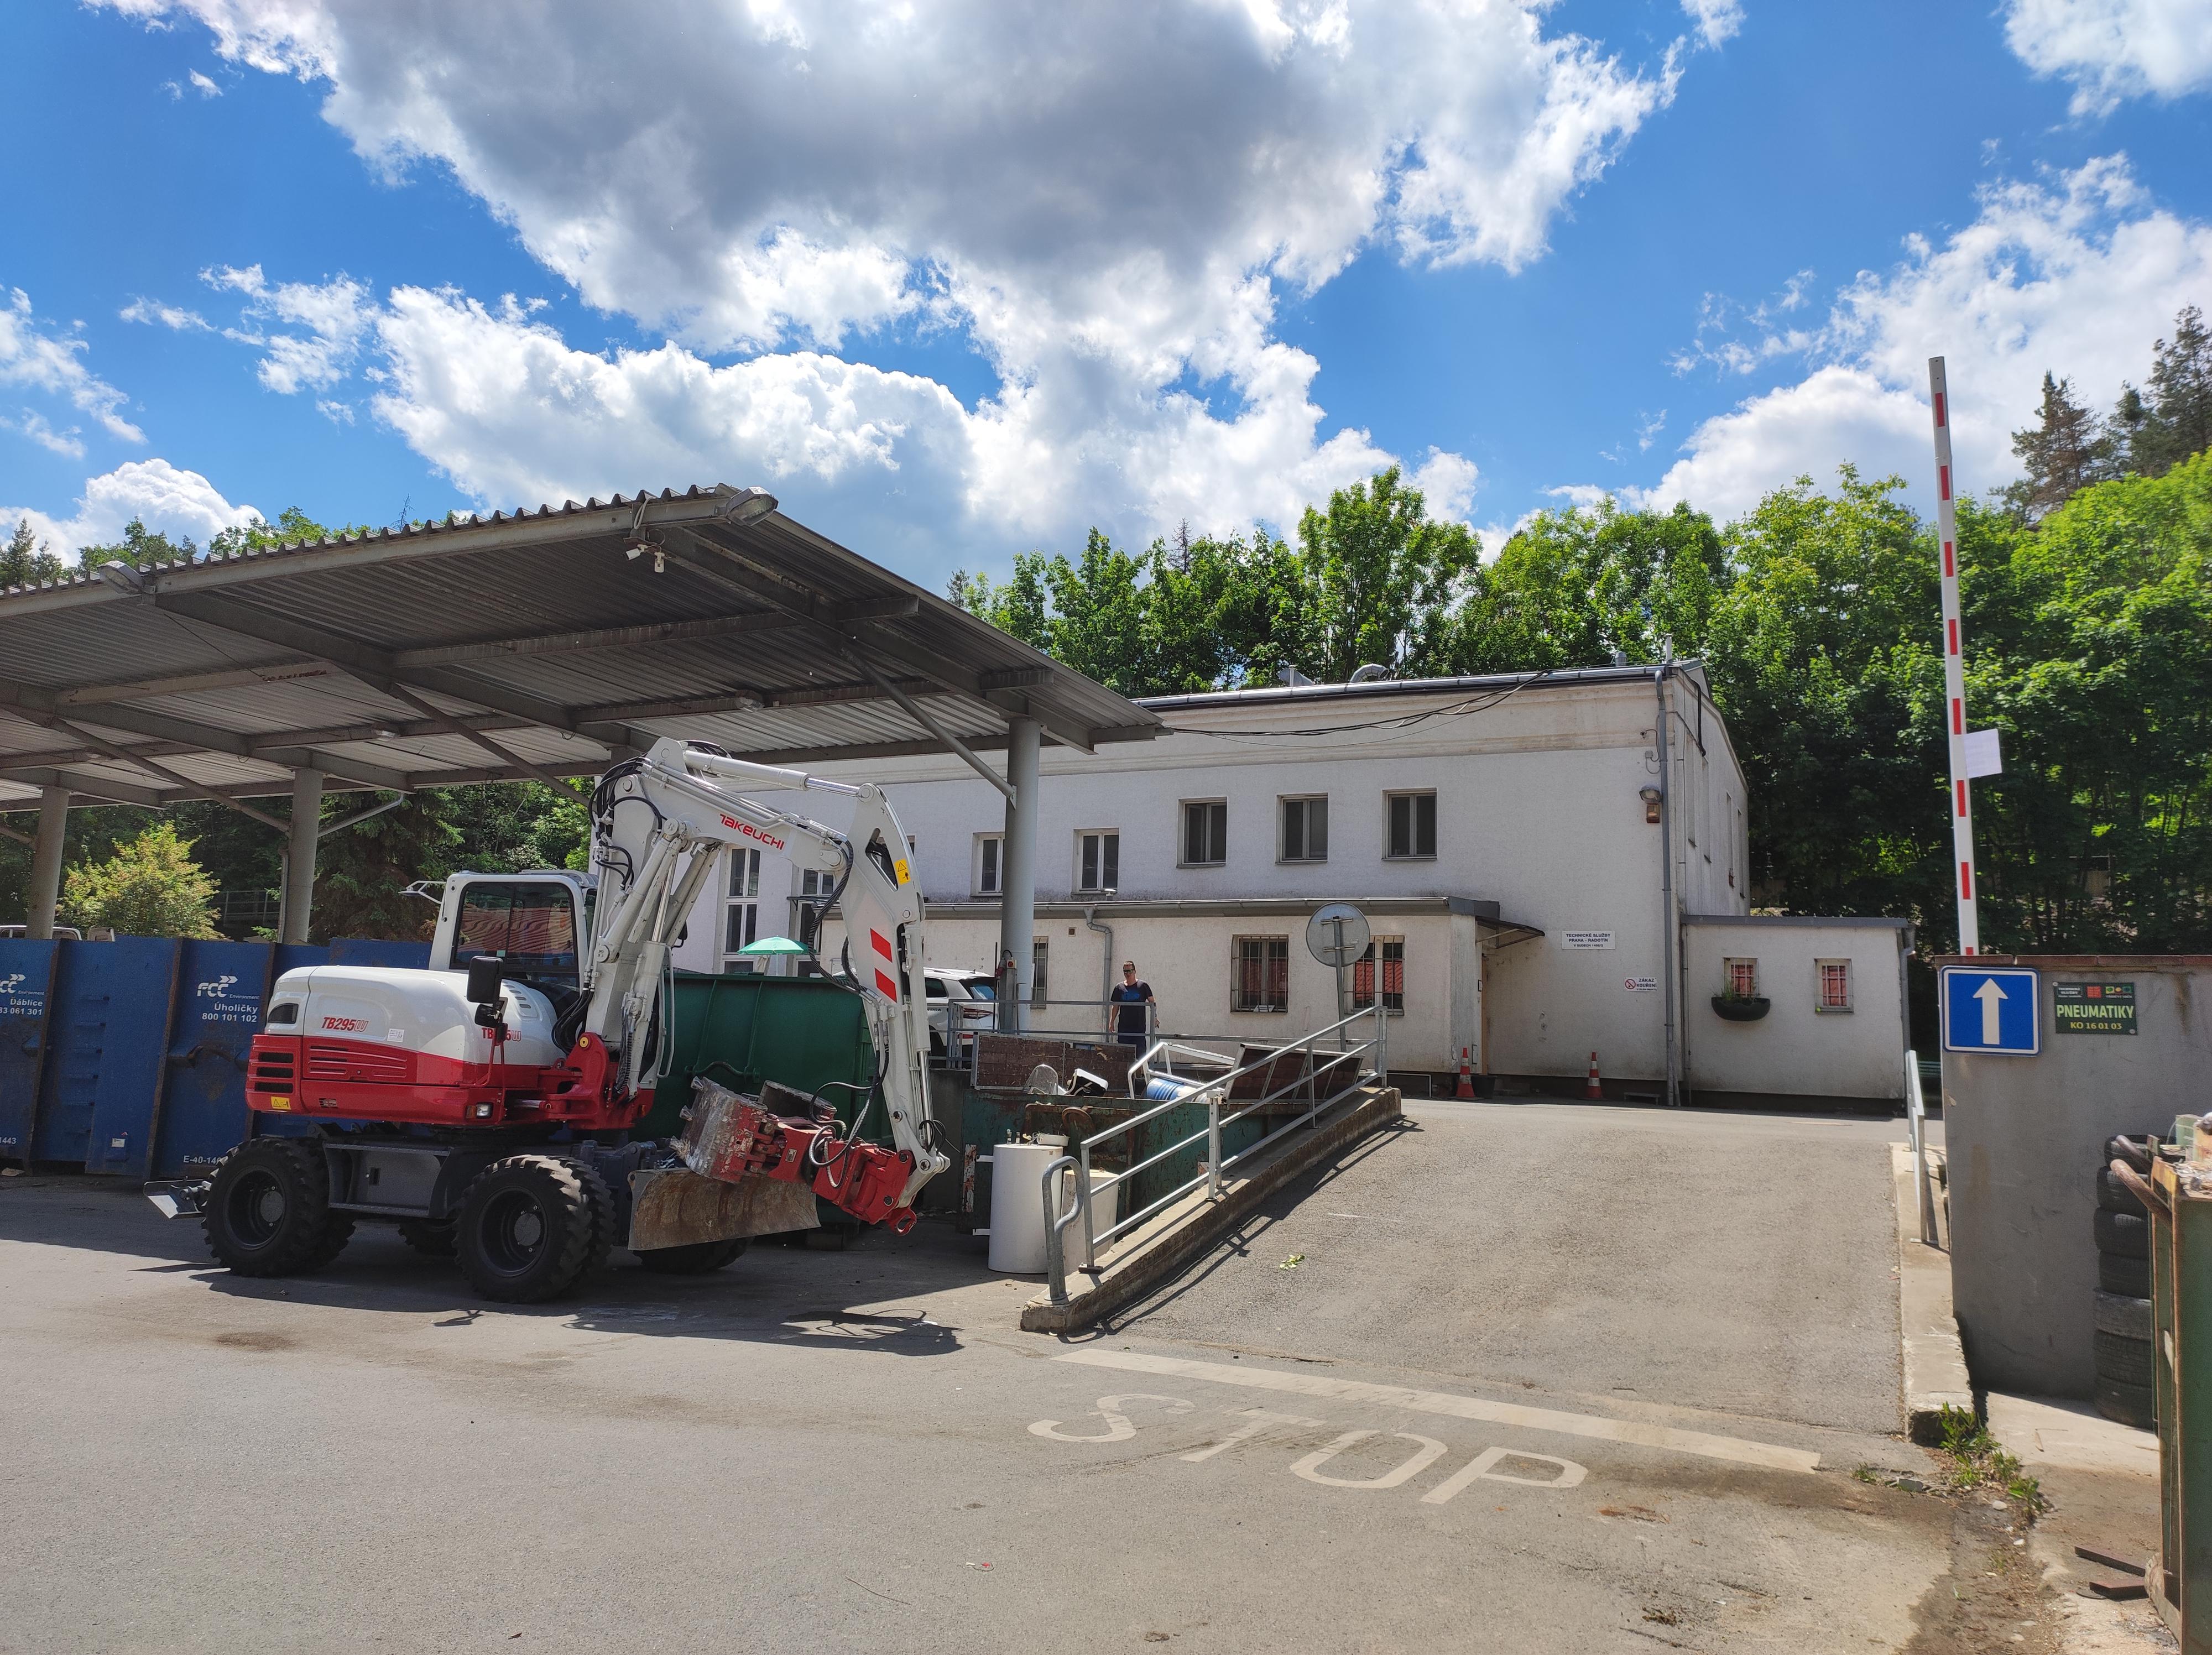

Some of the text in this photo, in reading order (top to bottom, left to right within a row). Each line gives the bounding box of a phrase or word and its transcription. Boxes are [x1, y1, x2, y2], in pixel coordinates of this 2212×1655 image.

[0, 980, 18, 994] CC
[197, 982, 229, 998] FCC
[11, 996, 43, 1006] Ďáblice
[214, 1001, 258, 1014] Úholičky
[2057, 1004, 2134, 1019] PNEUMATIKY
[321, 1017, 369, 1032] TB295W
[482, 1027, 521, 1042] TB5W
[1027, 1393, 1589, 1505] STOP
